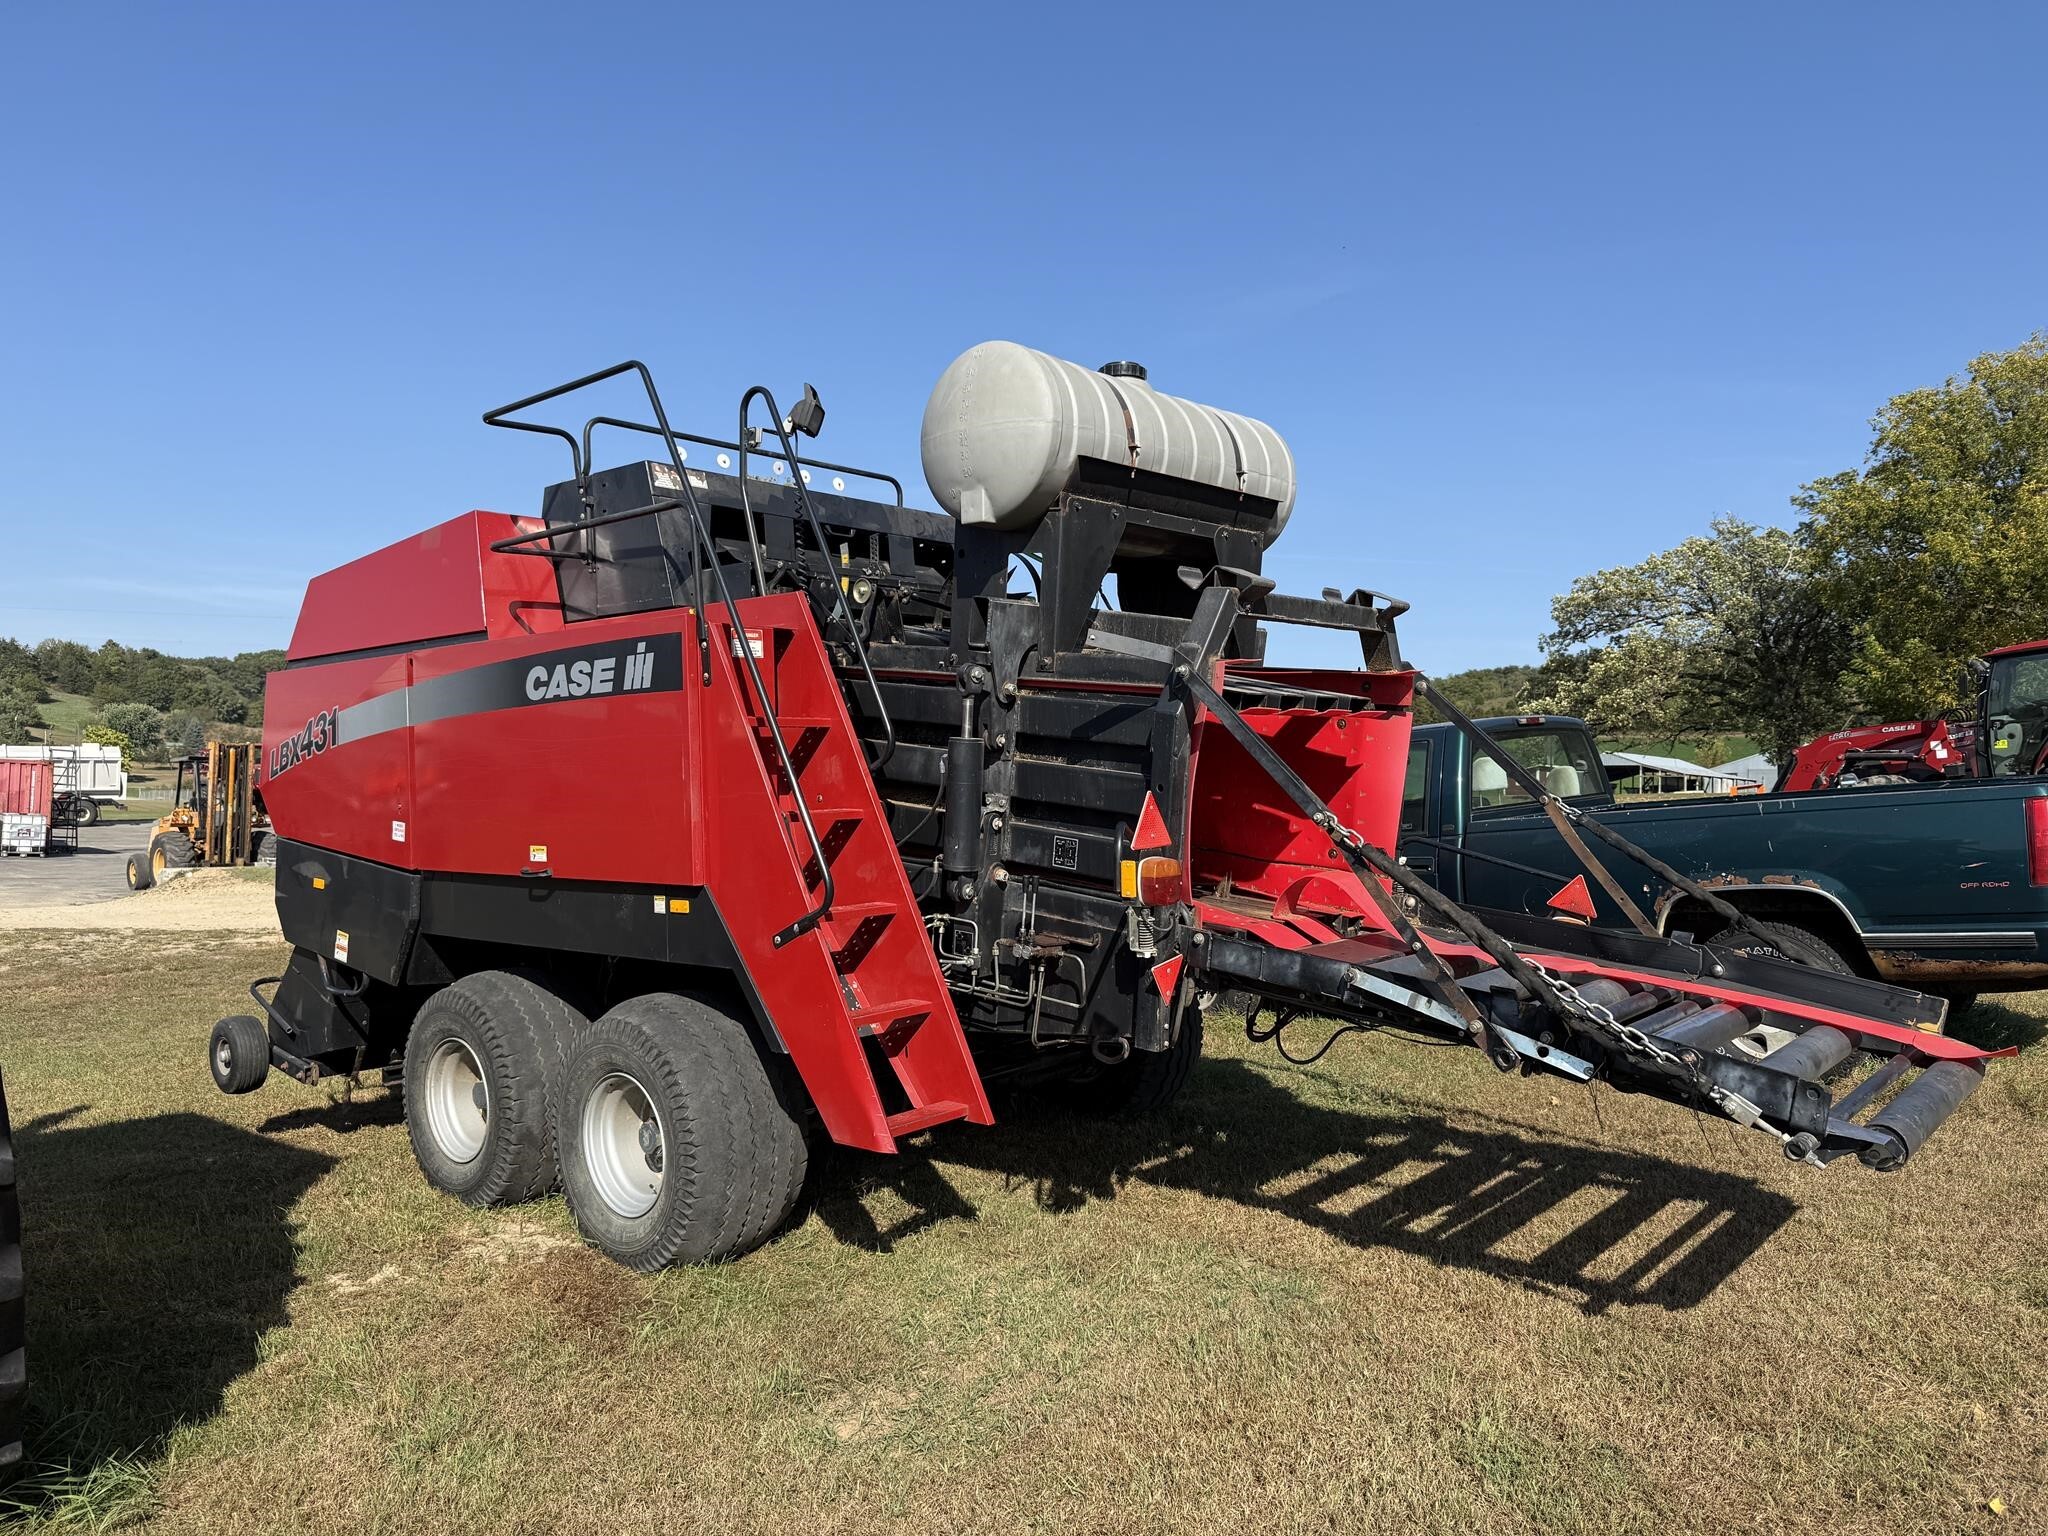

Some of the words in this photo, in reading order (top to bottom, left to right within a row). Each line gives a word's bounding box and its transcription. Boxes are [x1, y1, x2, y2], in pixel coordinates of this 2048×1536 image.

[525, 657, 616, 701] CASE
[269, 705, 339, 781] LBX431
[1881, 725, 1907, 733] CASE
